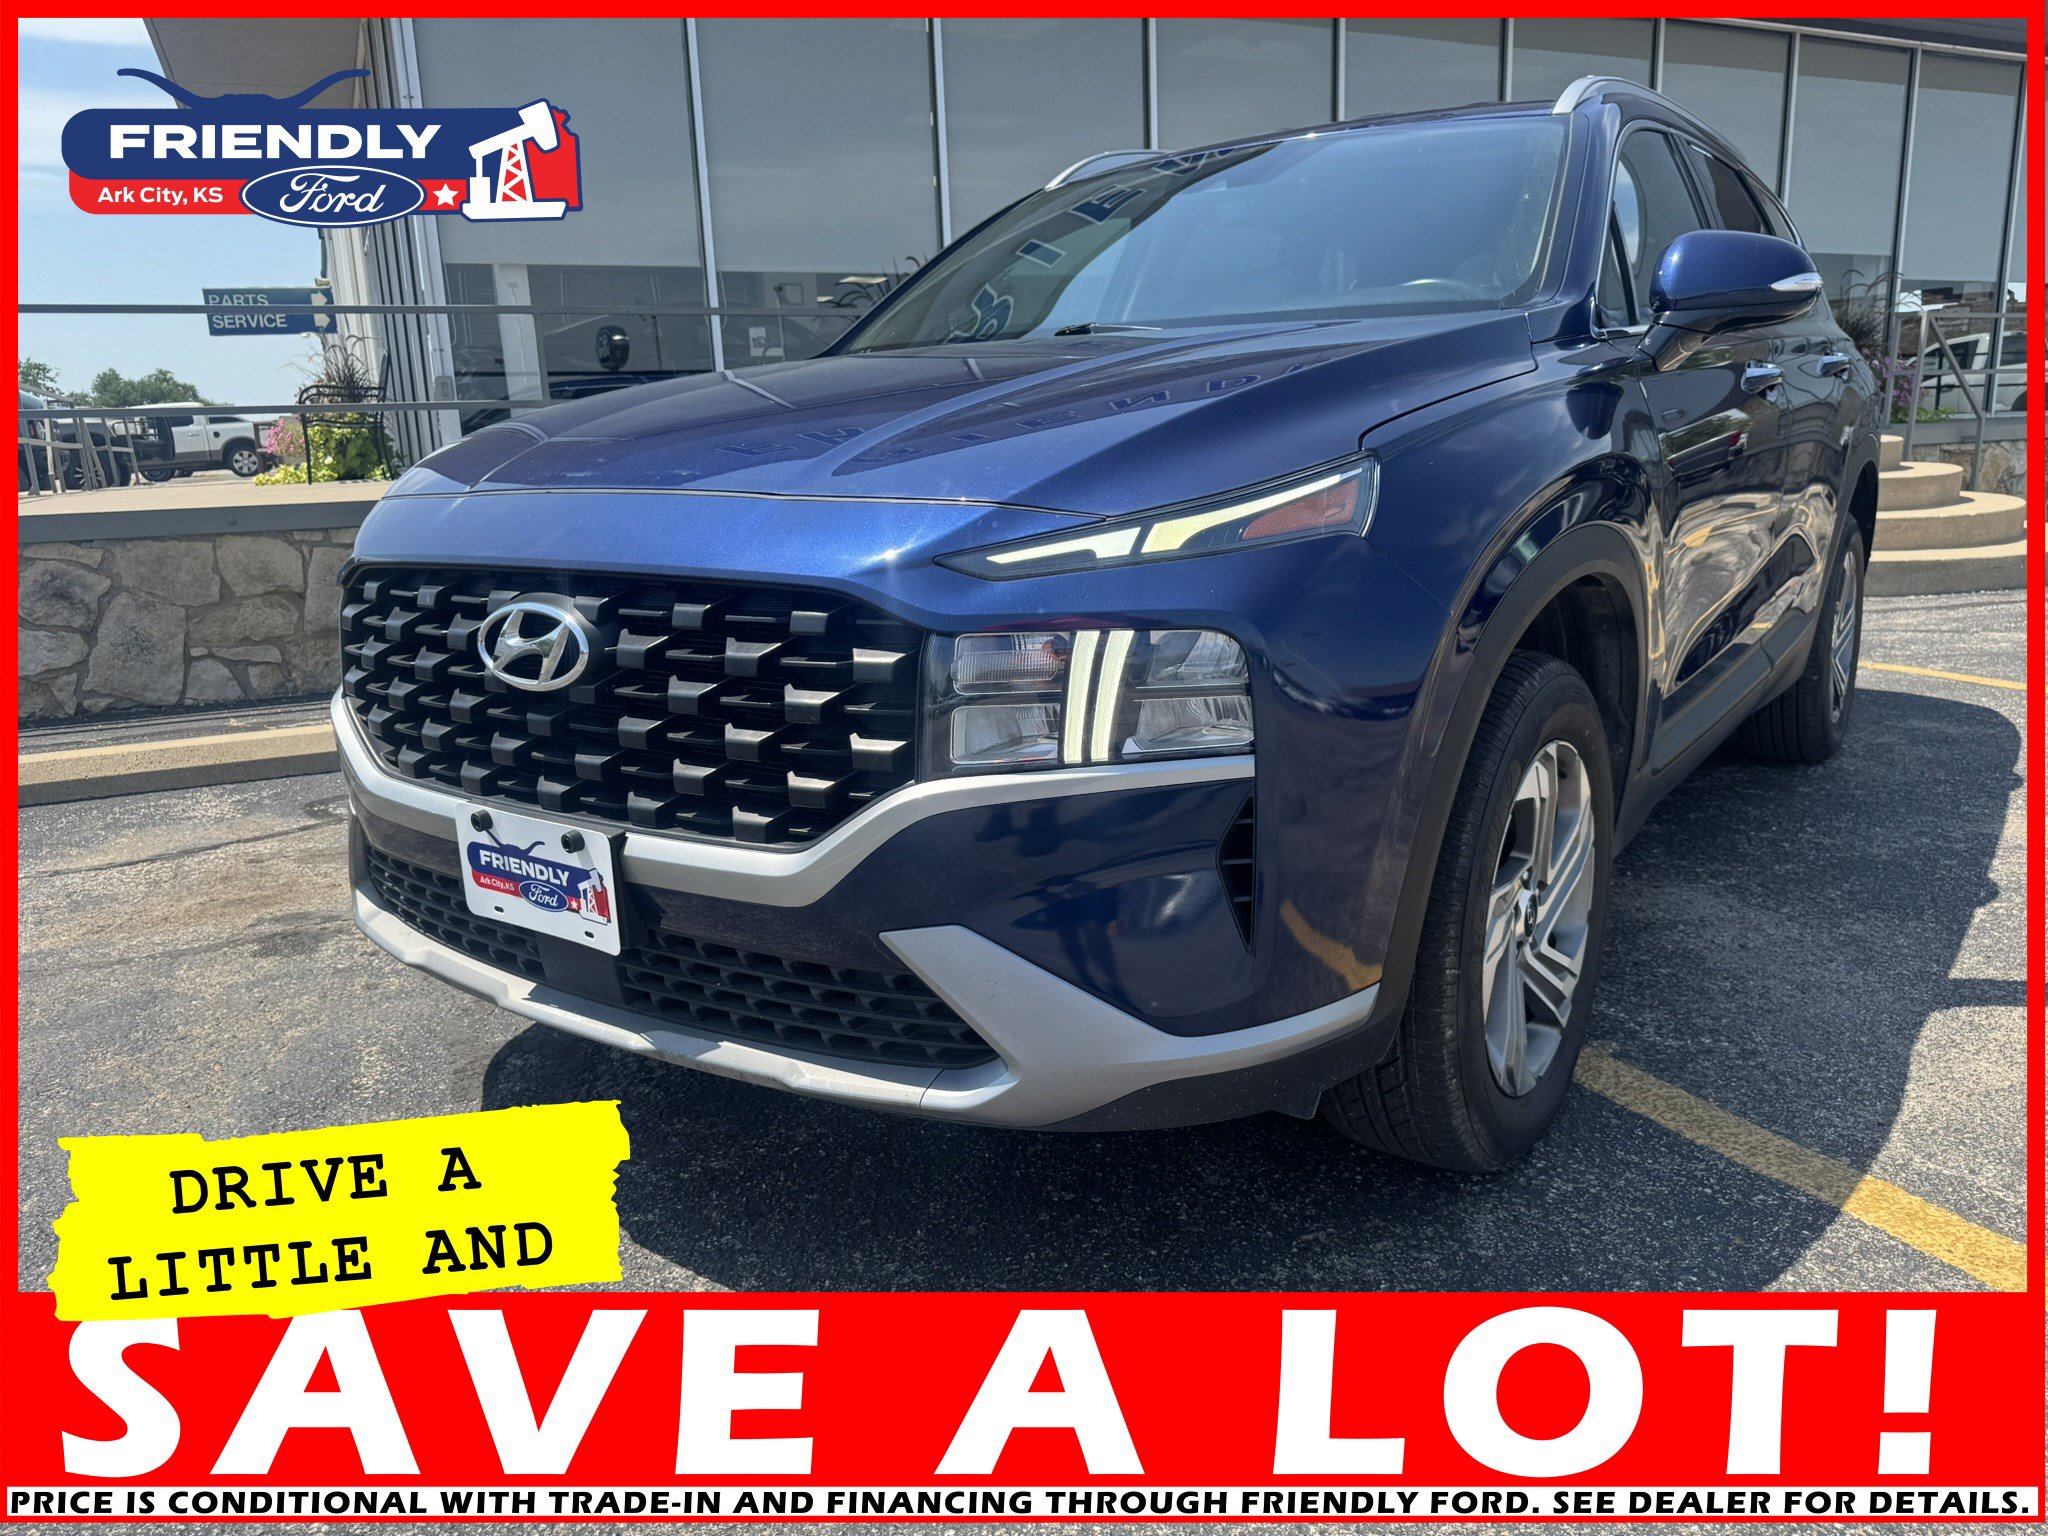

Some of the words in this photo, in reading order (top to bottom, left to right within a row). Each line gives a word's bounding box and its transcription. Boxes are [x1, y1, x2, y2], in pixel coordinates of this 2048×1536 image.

[208, 294, 268, 306] PARTS
[212, 313, 288, 329] SERVICE
[479, 849, 570, 887] FRIENDLY
[480, 876, 491, 886] Ark
[528, 883, 559, 907] Ford
